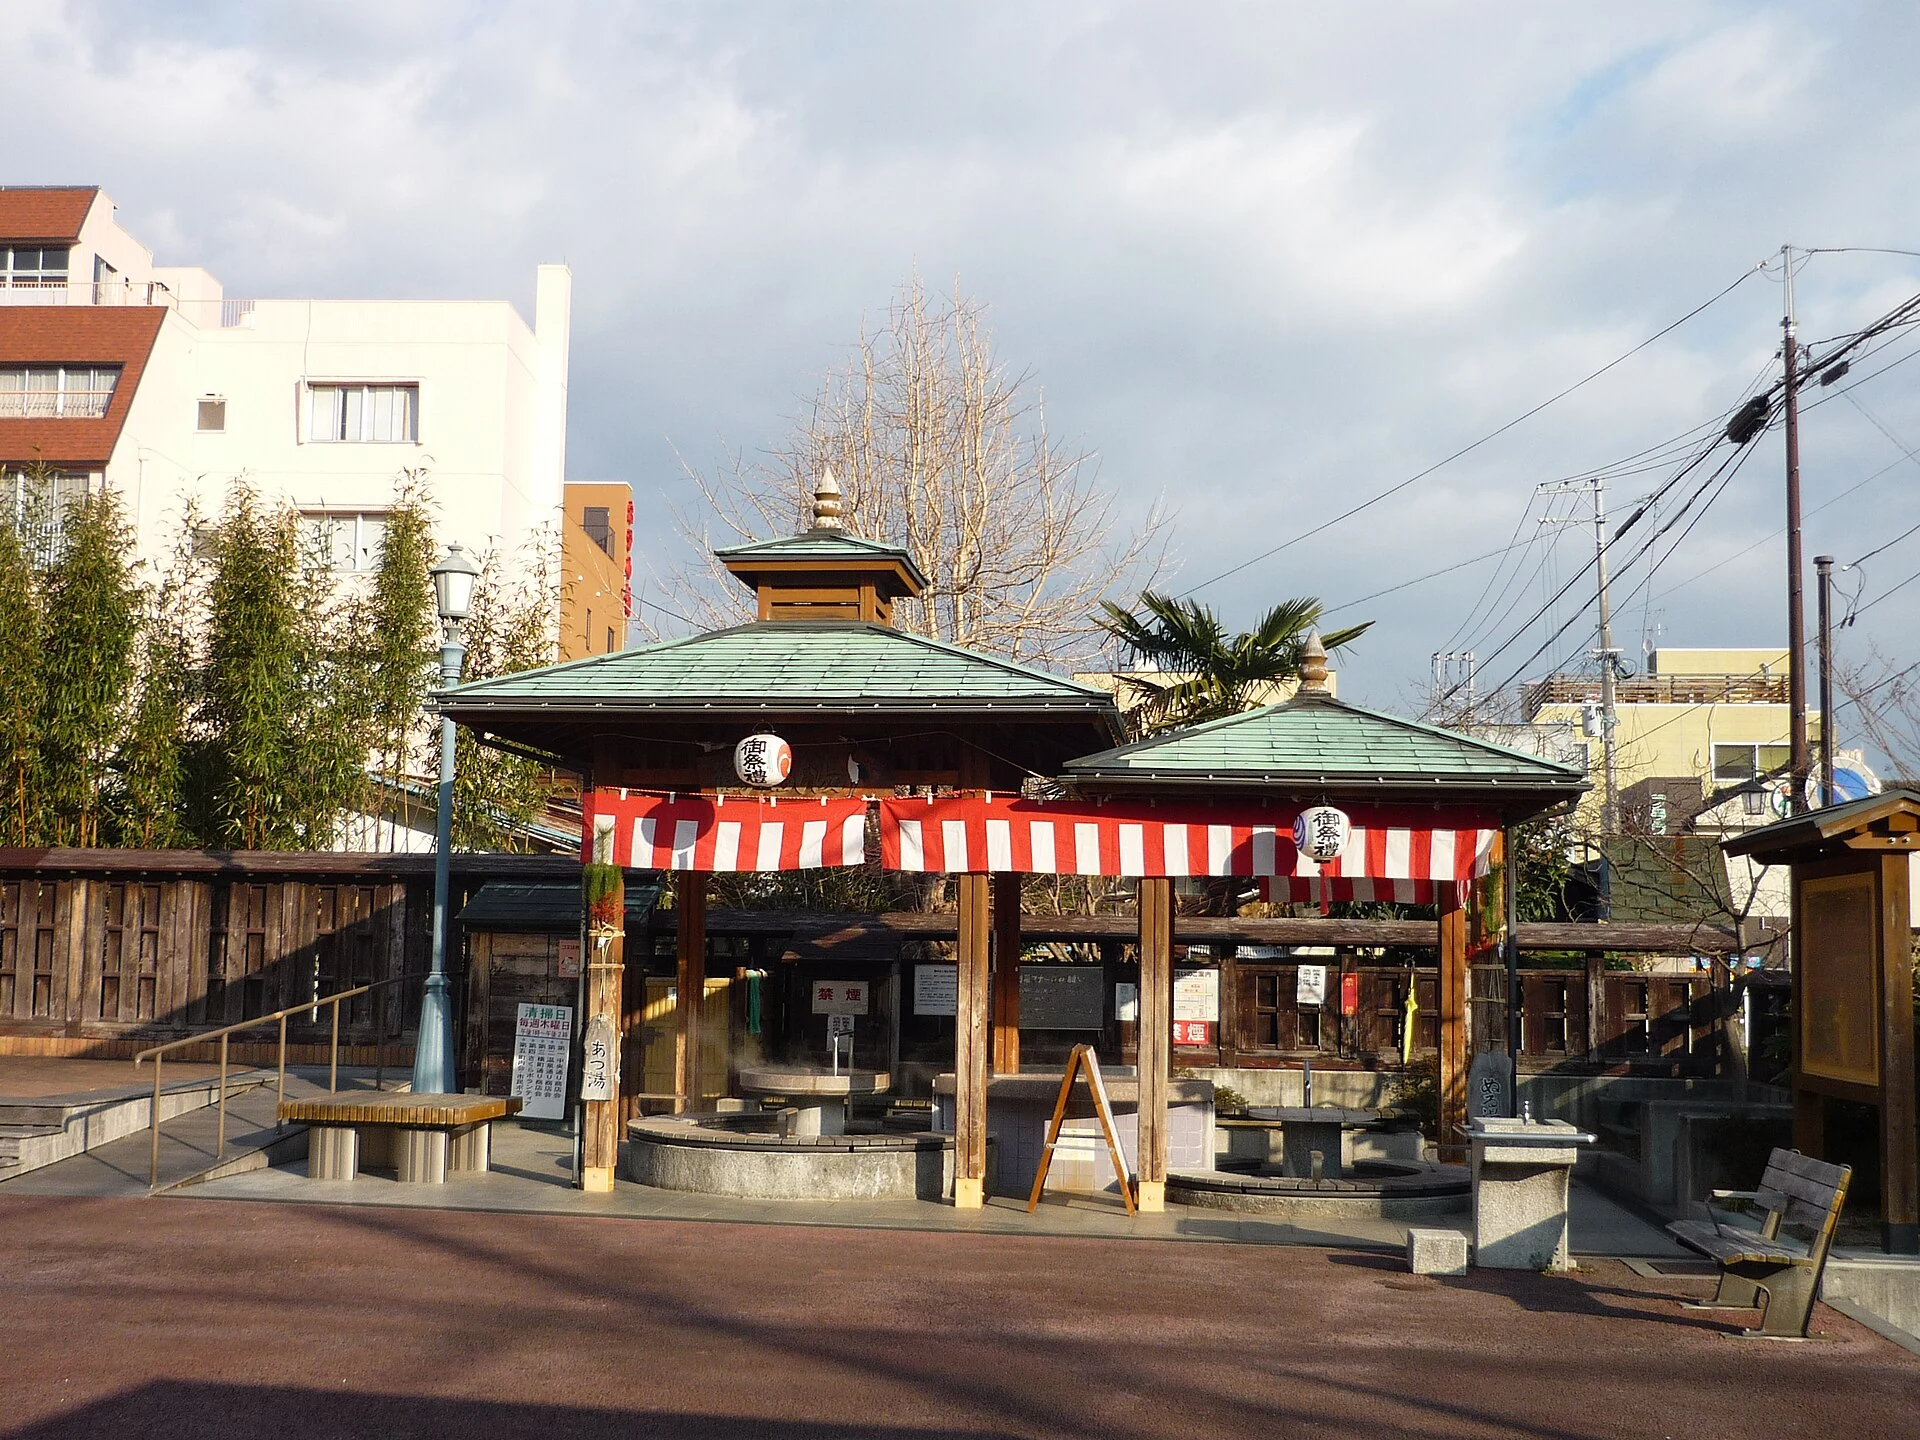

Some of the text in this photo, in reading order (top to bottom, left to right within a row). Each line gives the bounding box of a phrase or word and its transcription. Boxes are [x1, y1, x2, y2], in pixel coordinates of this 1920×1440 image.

[818, 988, 861, 1001] 禁煙
[525, 1007, 565, 1020] 清掃日
[520, 1017, 569, 1030] 毎週木曜日
[588, 1040, 606, 1089] あつ湯
